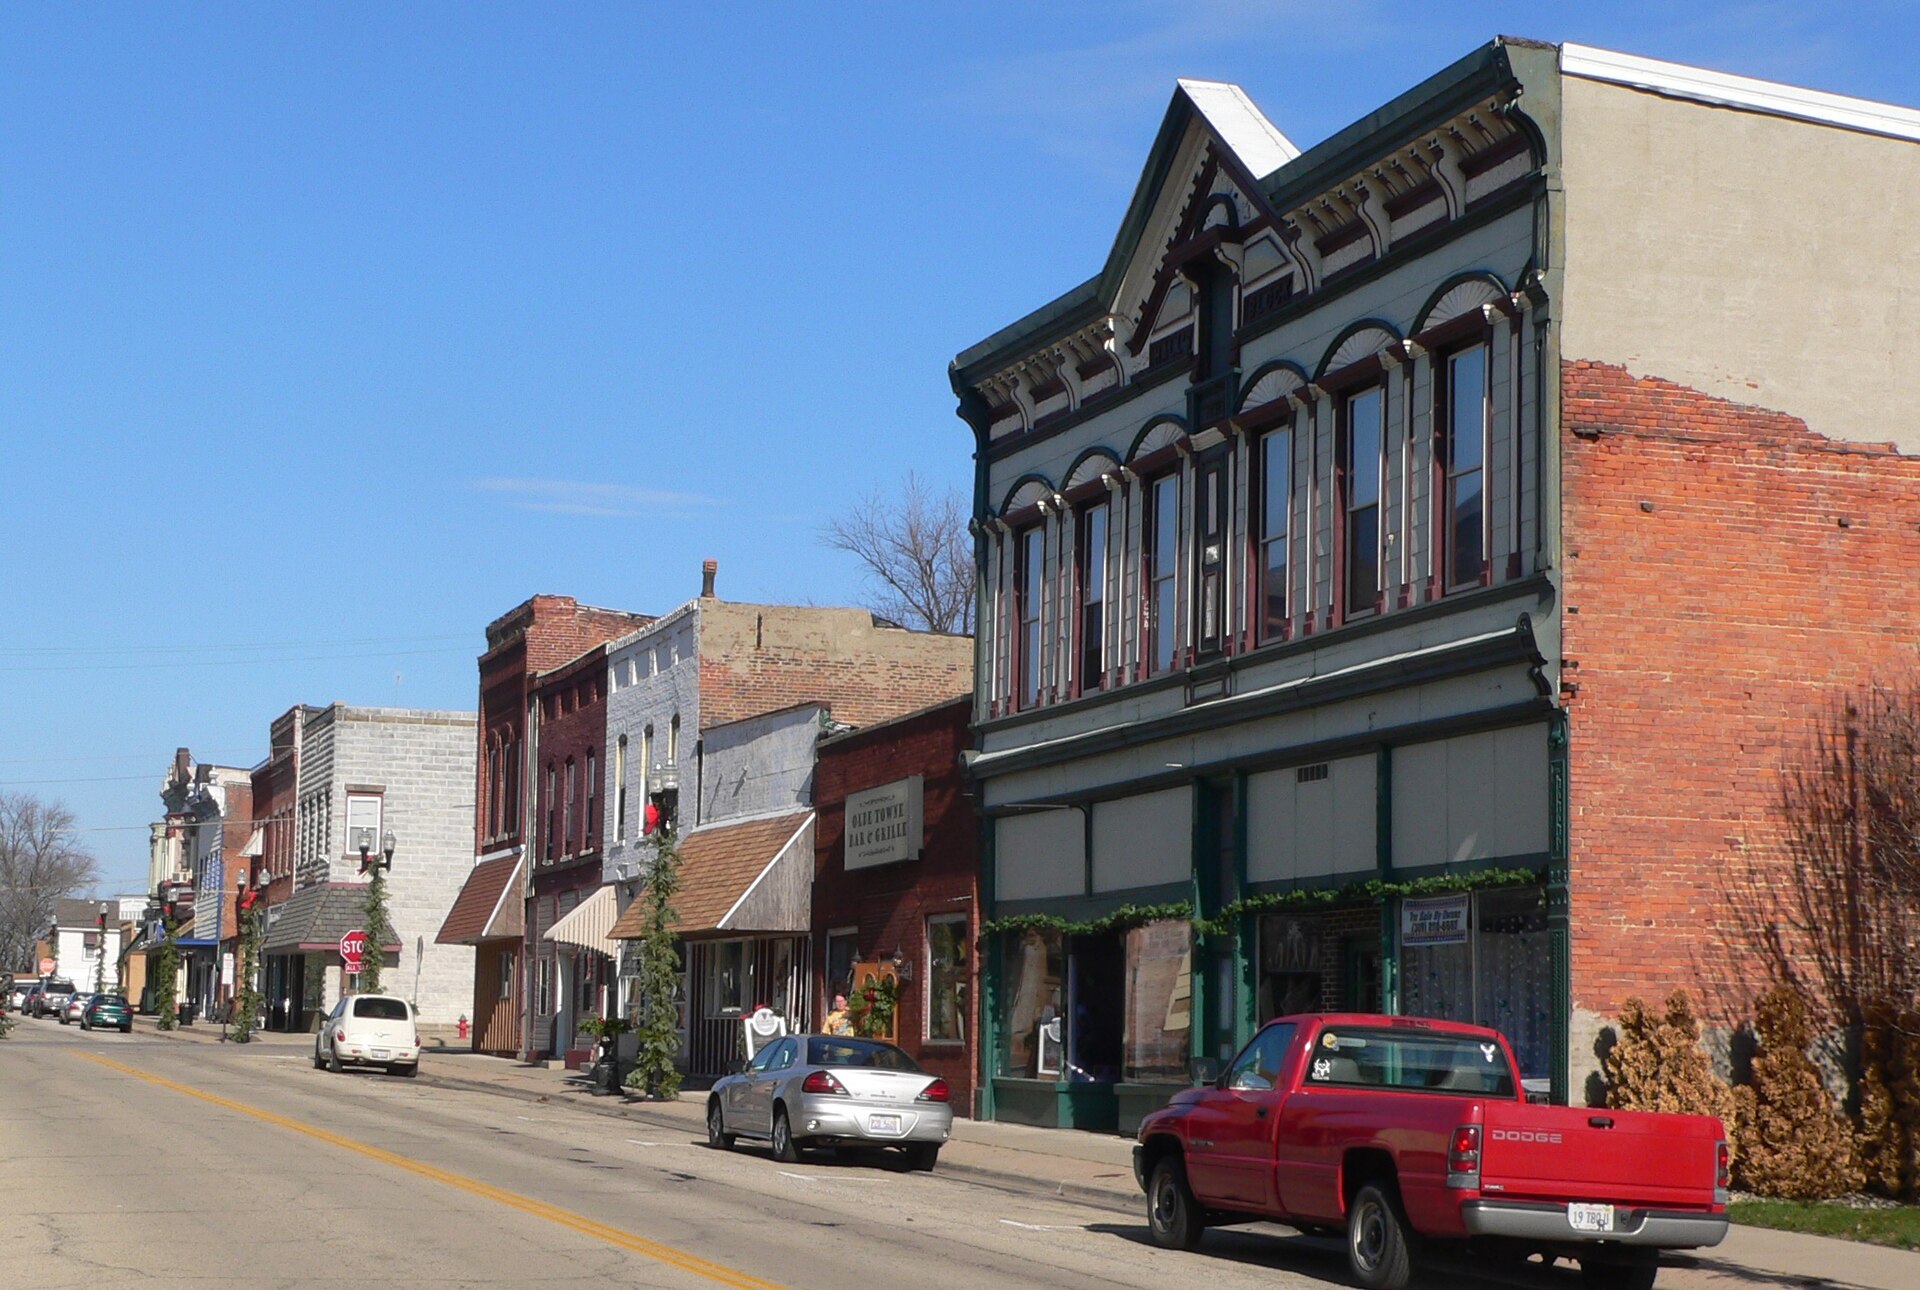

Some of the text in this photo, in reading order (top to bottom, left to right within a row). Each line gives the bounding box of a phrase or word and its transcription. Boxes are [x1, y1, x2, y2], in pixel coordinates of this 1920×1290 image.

[875, 803, 904, 823] TOWNE
[848, 832, 866, 848] BAR
[874, 822, 907, 842] GRILLE
[343, 940, 364, 953] STO
[1492, 1129, 1562, 1144] DODGE
